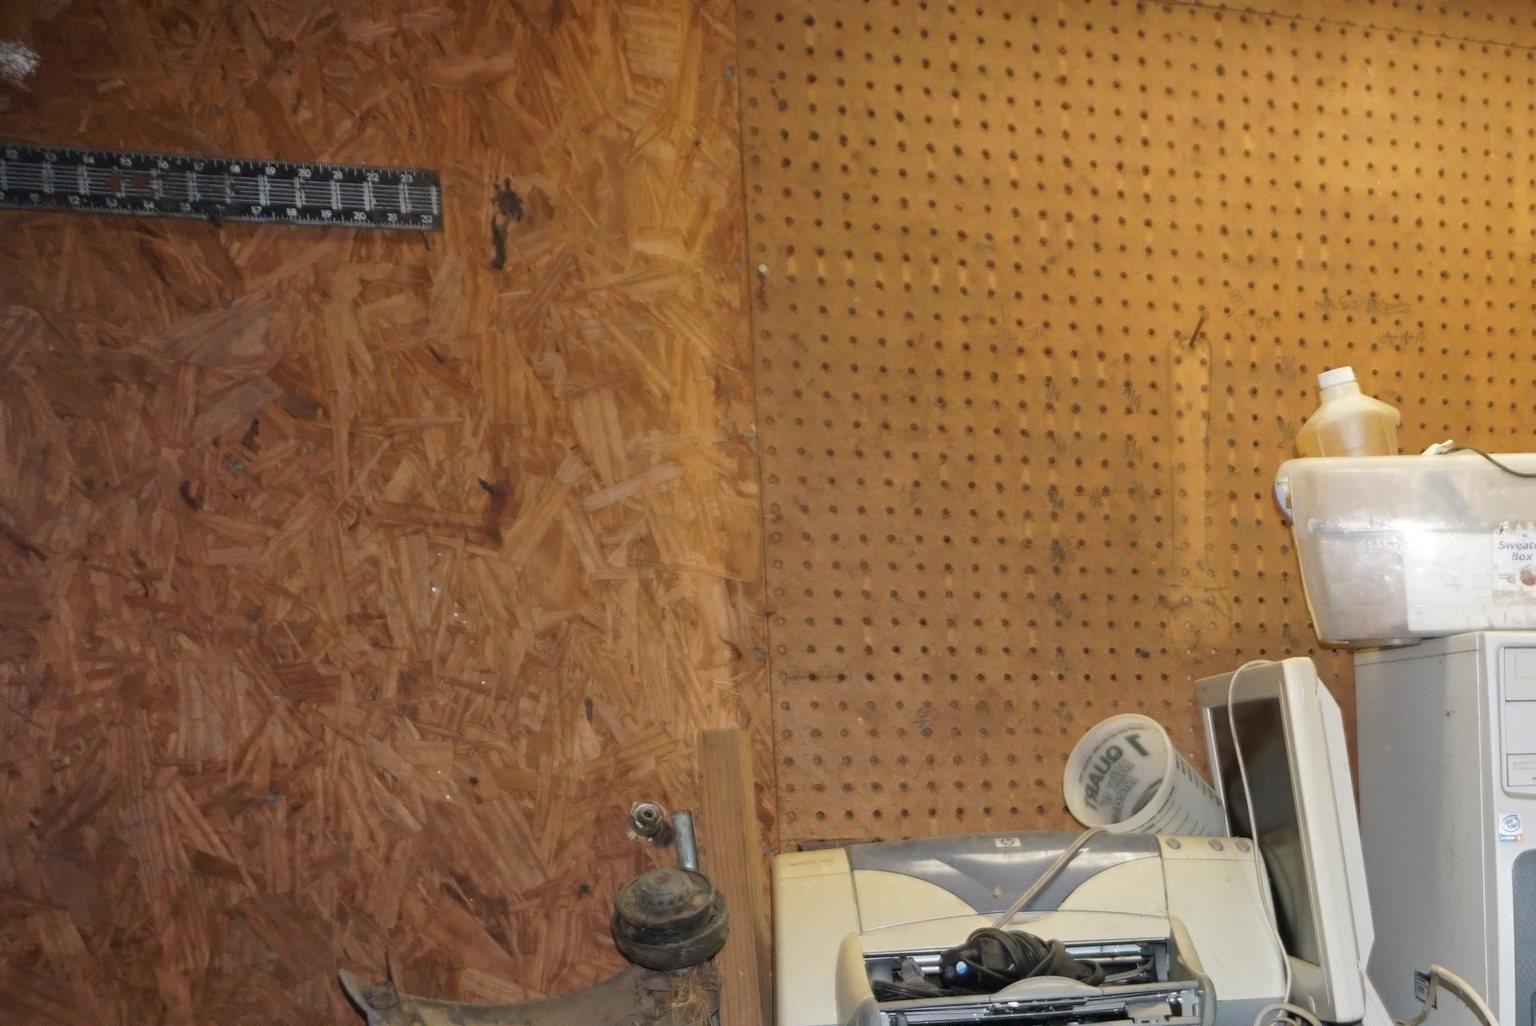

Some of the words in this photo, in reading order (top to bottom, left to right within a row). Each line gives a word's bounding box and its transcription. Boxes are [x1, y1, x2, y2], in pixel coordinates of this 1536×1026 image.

[265, 166, 276, 176] 19
[298, 168, 312, 179] 20
[332, 170, 343, 180] 21
[366, 172, 379, 182] 22
[400, 174, 413, 184] 23
[353, 211, 367, 221] 20
[387, 212, 398, 222] 21
[1511, 552, 1533, 562] Box
